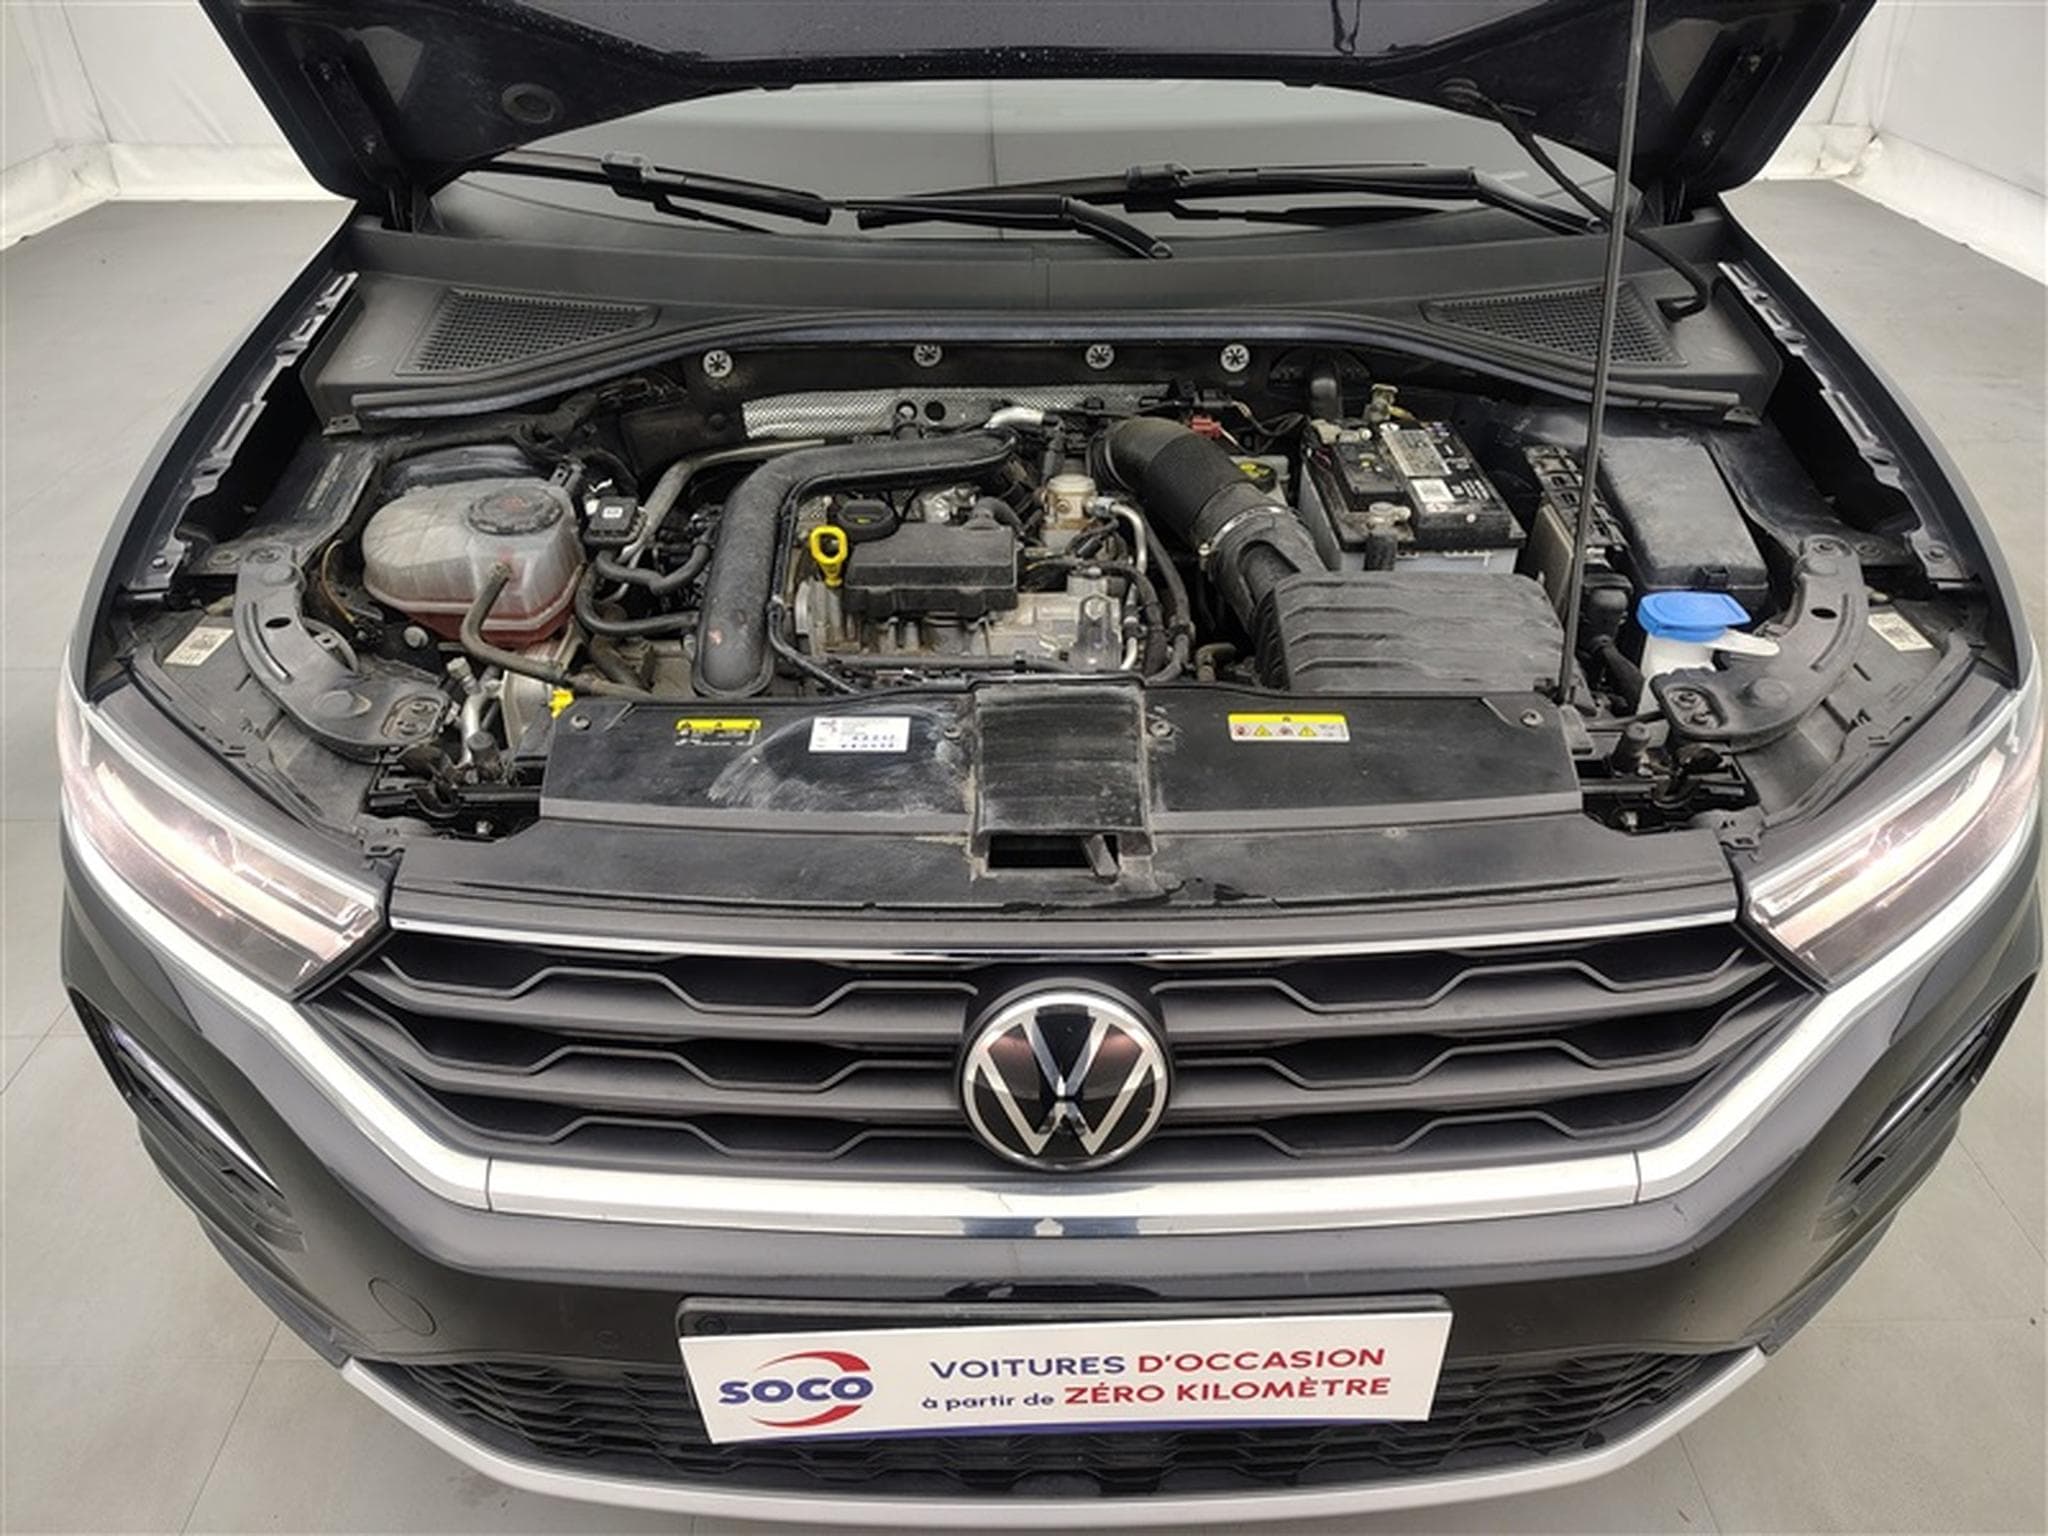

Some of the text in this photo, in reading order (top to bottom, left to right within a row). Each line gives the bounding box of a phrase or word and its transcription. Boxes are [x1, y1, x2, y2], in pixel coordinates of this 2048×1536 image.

[929, 1348, 1386, 1379] VOITURES D'OCCASION
[718, 1376, 874, 1405] SOCO
[922, 1377, 1391, 1412] à partir de ZÉRO KILOMÈTRE
